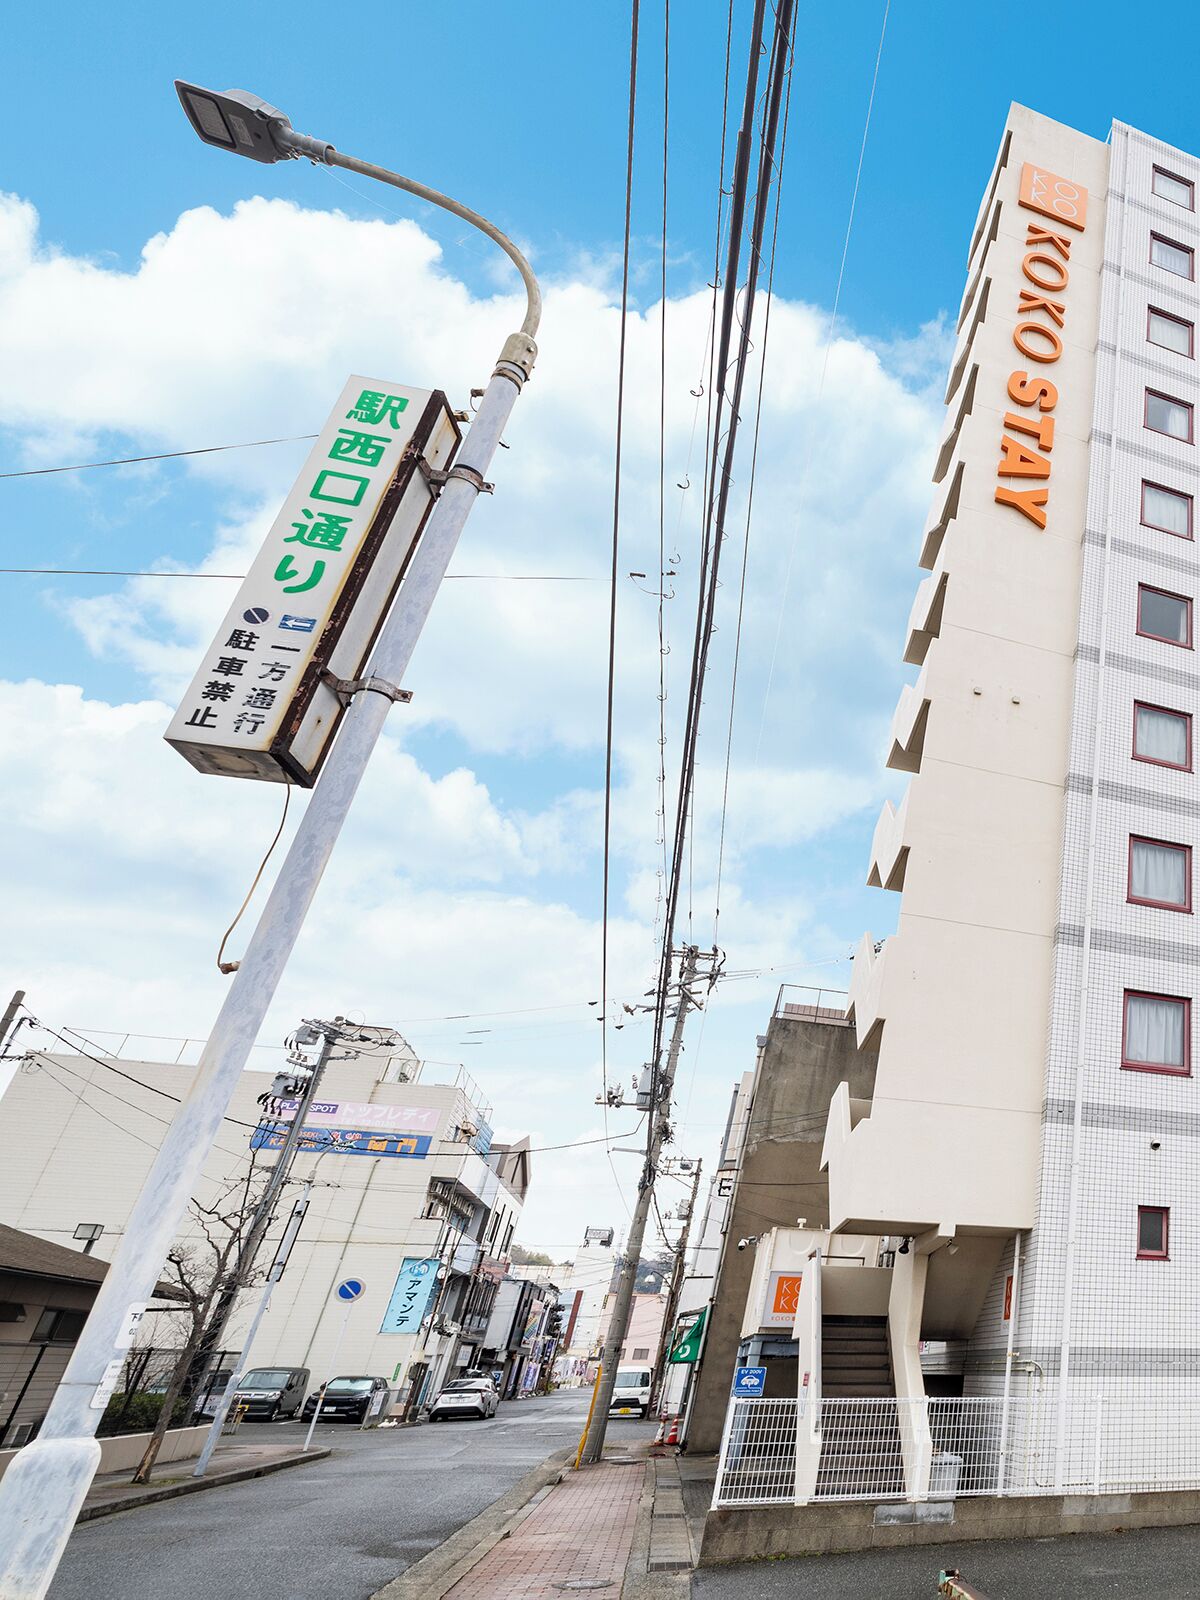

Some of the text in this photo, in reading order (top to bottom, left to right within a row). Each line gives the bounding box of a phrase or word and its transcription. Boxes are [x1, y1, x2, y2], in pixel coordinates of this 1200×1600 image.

[994, 223, 1072, 530] KOKO STAY
[273, 389, 410, 594] 駅西口通り
[184, 628, 258, 729] 駐車禁止
[232, 645, 301, 735] 一方通行
[309, 1103, 337, 1114] SPOT
[396, 1279, 422, 1327] アマンテ
